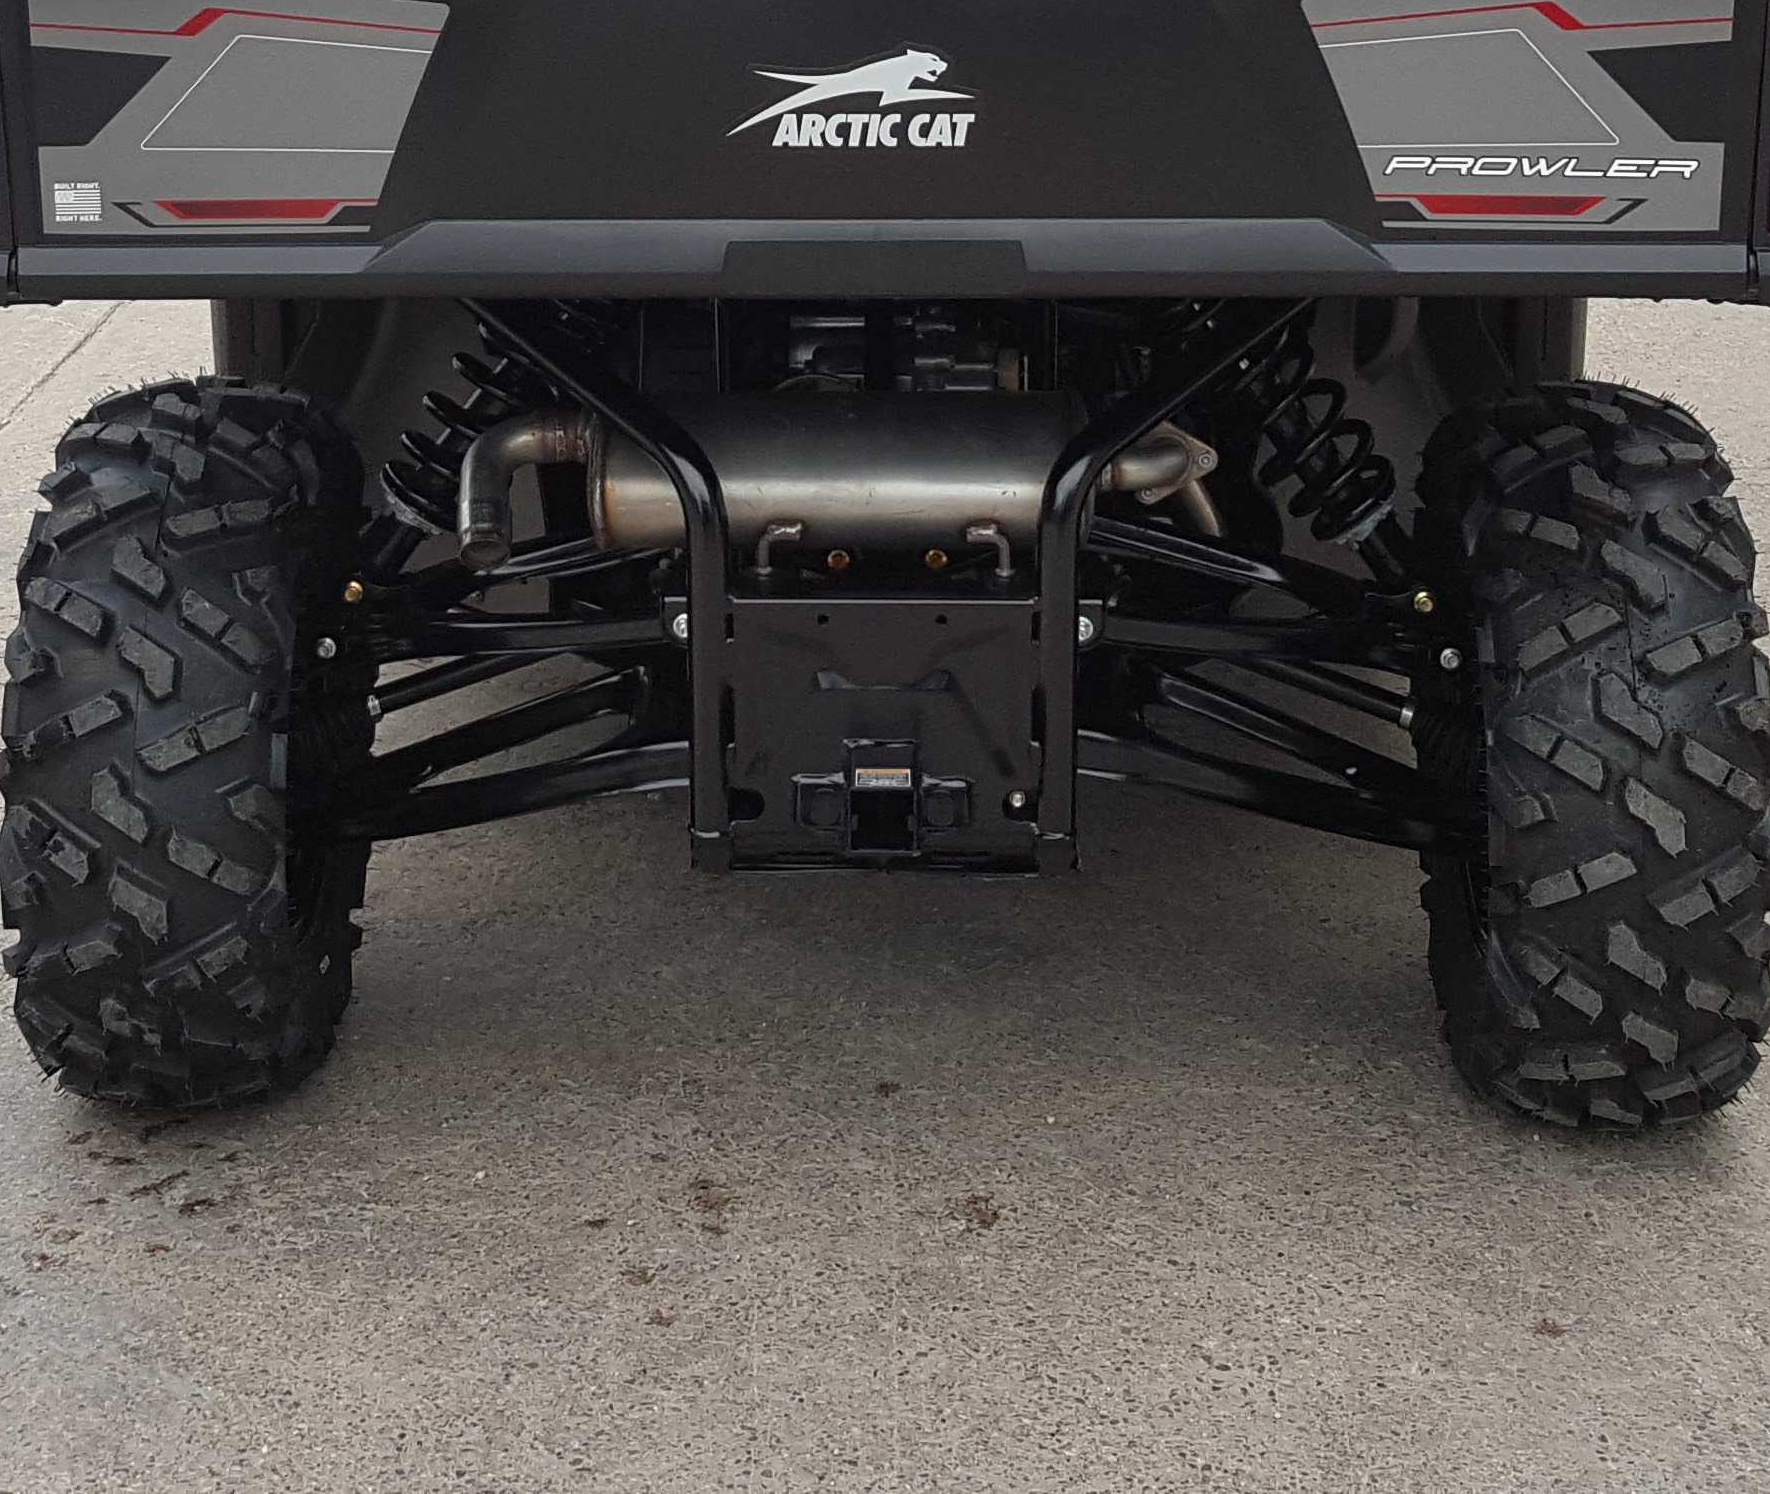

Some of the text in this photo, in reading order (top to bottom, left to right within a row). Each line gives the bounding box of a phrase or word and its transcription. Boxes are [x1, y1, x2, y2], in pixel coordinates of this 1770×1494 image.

[772, 113, 975, 147] ARCTIC CAT
[1383, 155, 1700, 180] PROWLER
